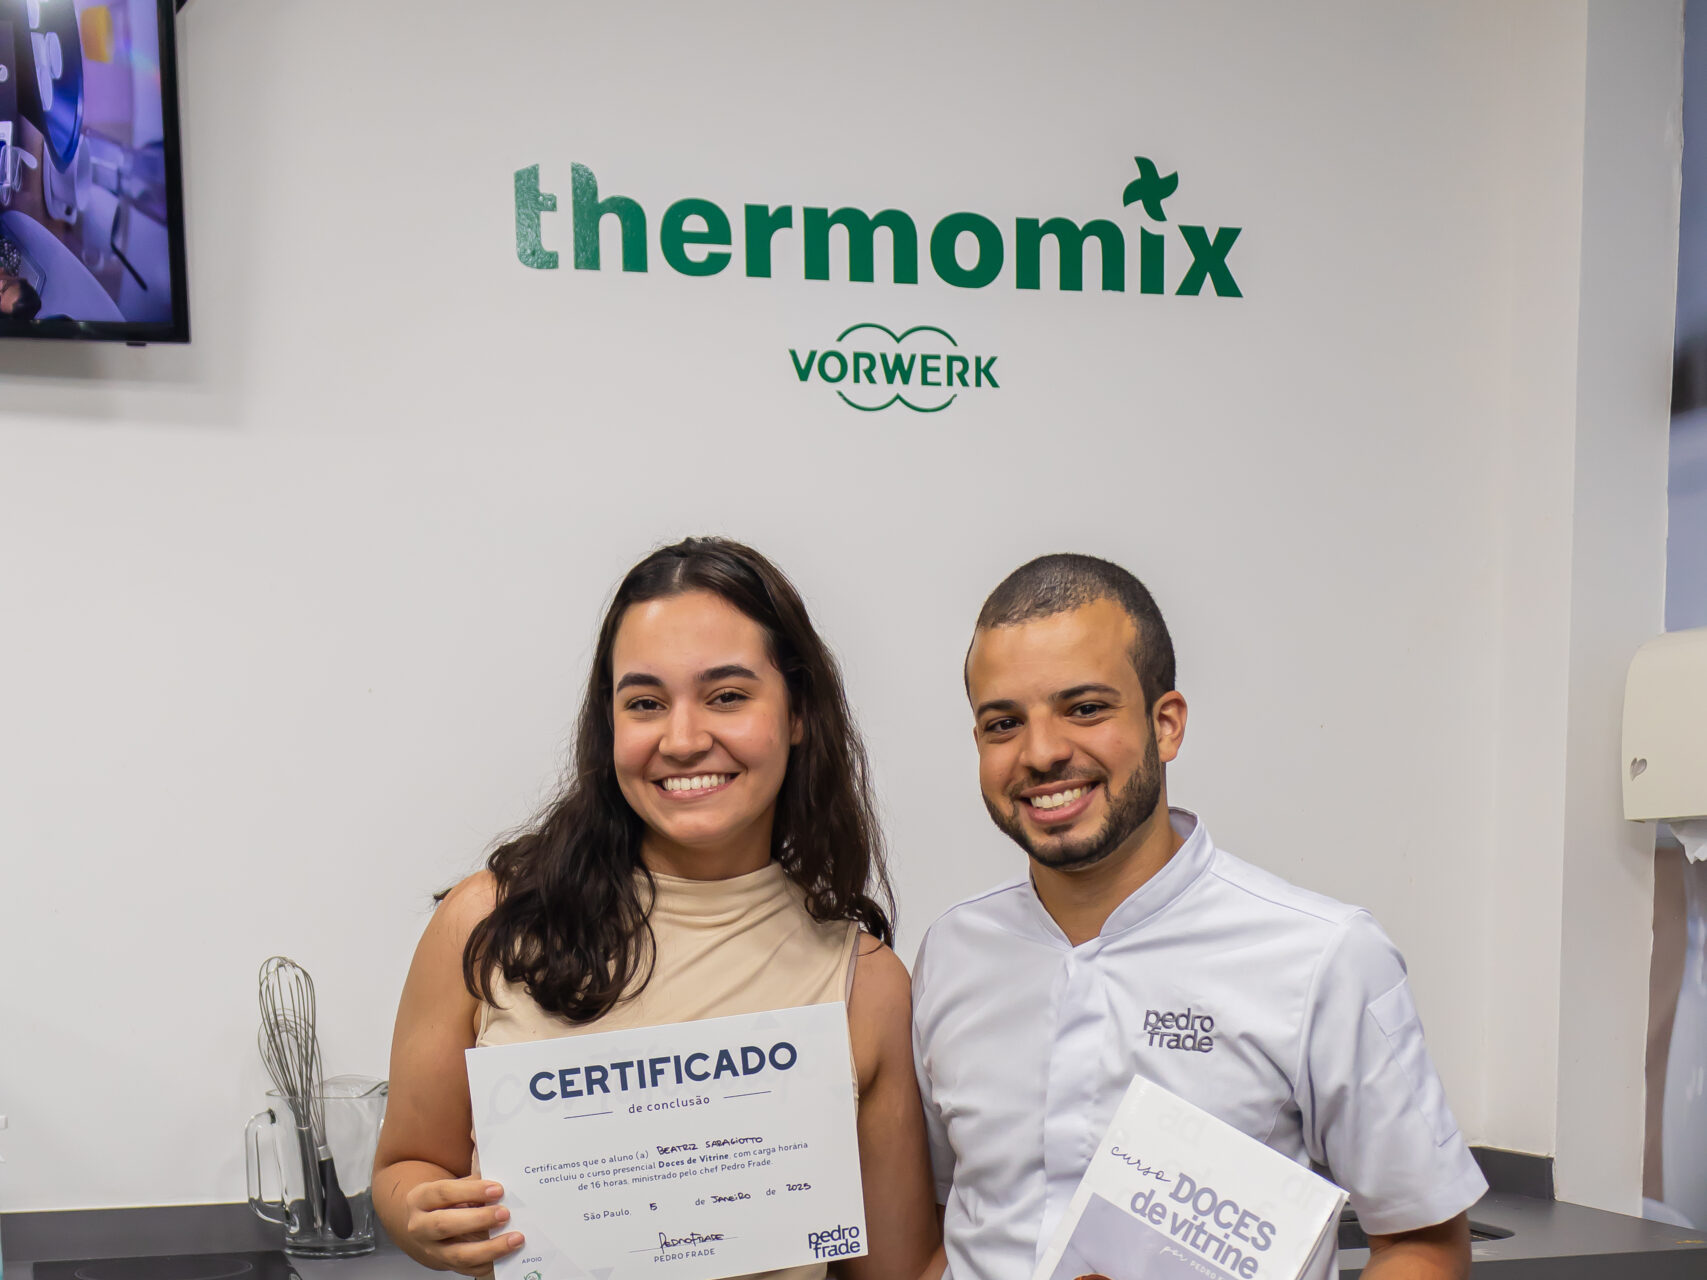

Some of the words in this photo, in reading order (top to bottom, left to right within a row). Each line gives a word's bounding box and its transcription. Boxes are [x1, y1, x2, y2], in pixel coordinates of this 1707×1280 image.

[514, 156, 1243, 298] thermomix
[788, 348, 1000, 388] VORWERK
[1143, 1007, 1215, 1033] pedro
[1147, 1026, 1214, 1053] frade
[529, 1041, 797, 1101] CERTIFICADO
[628, 1102, 645, 1114] de
[647, 1095, 711, 1112] conclusão
[524, 1161, 581, 1174] Certificamos
[582, 1158, 599, 1168] que
[608, 1153, 634, 1163] aluno
[635, 1150, 649, 1161] (a)
[539, 1173, 577, 1184] concluiu
[587, 1169, 611, 1178] curso
[612, 1161, 656, 1176] presencial
[658, 1158, 685, 1169] Doces
[686, 1157, 697, 1165] de
[733, 1150, 751, 1159] com
[753, 1147, 776, 1156] carga
[778, 1141, 808, 1152] horária
[577, 1182, 588, 1191] de
[590, 1180, 601, 1189] 16
[631, 1170, 677, 1184] ministrado
[679, 1167, 698, 1179] pelo
[699, 1165, 718, 1175] chef
[721, 1162, 746, 1172] Pedro
[785, 1182, 812, 1192] 2025
[695, 1198, 705, 1206] de
[765, 1188, 776, 1196] de
[1111, 1146, 1172, 1183] curso
[1168, 1172, 1277, 1252] DOCES
[583, 1211, 601, 1221] São
[808, 1224, 860, 1249] pedro
[1130, 1188, 1168, 1226] de
[1170, 1211, 1259, 1280] vitrine
[521, 1255, 543, 1264] APOIO
[654, 1252, 684, 1263] PEDRO
[686, 1247, 716, 1259] FRADE
[813, 1238, 861, 1259] frade
[1190, 1260, 1217, 1280] PEDRO
